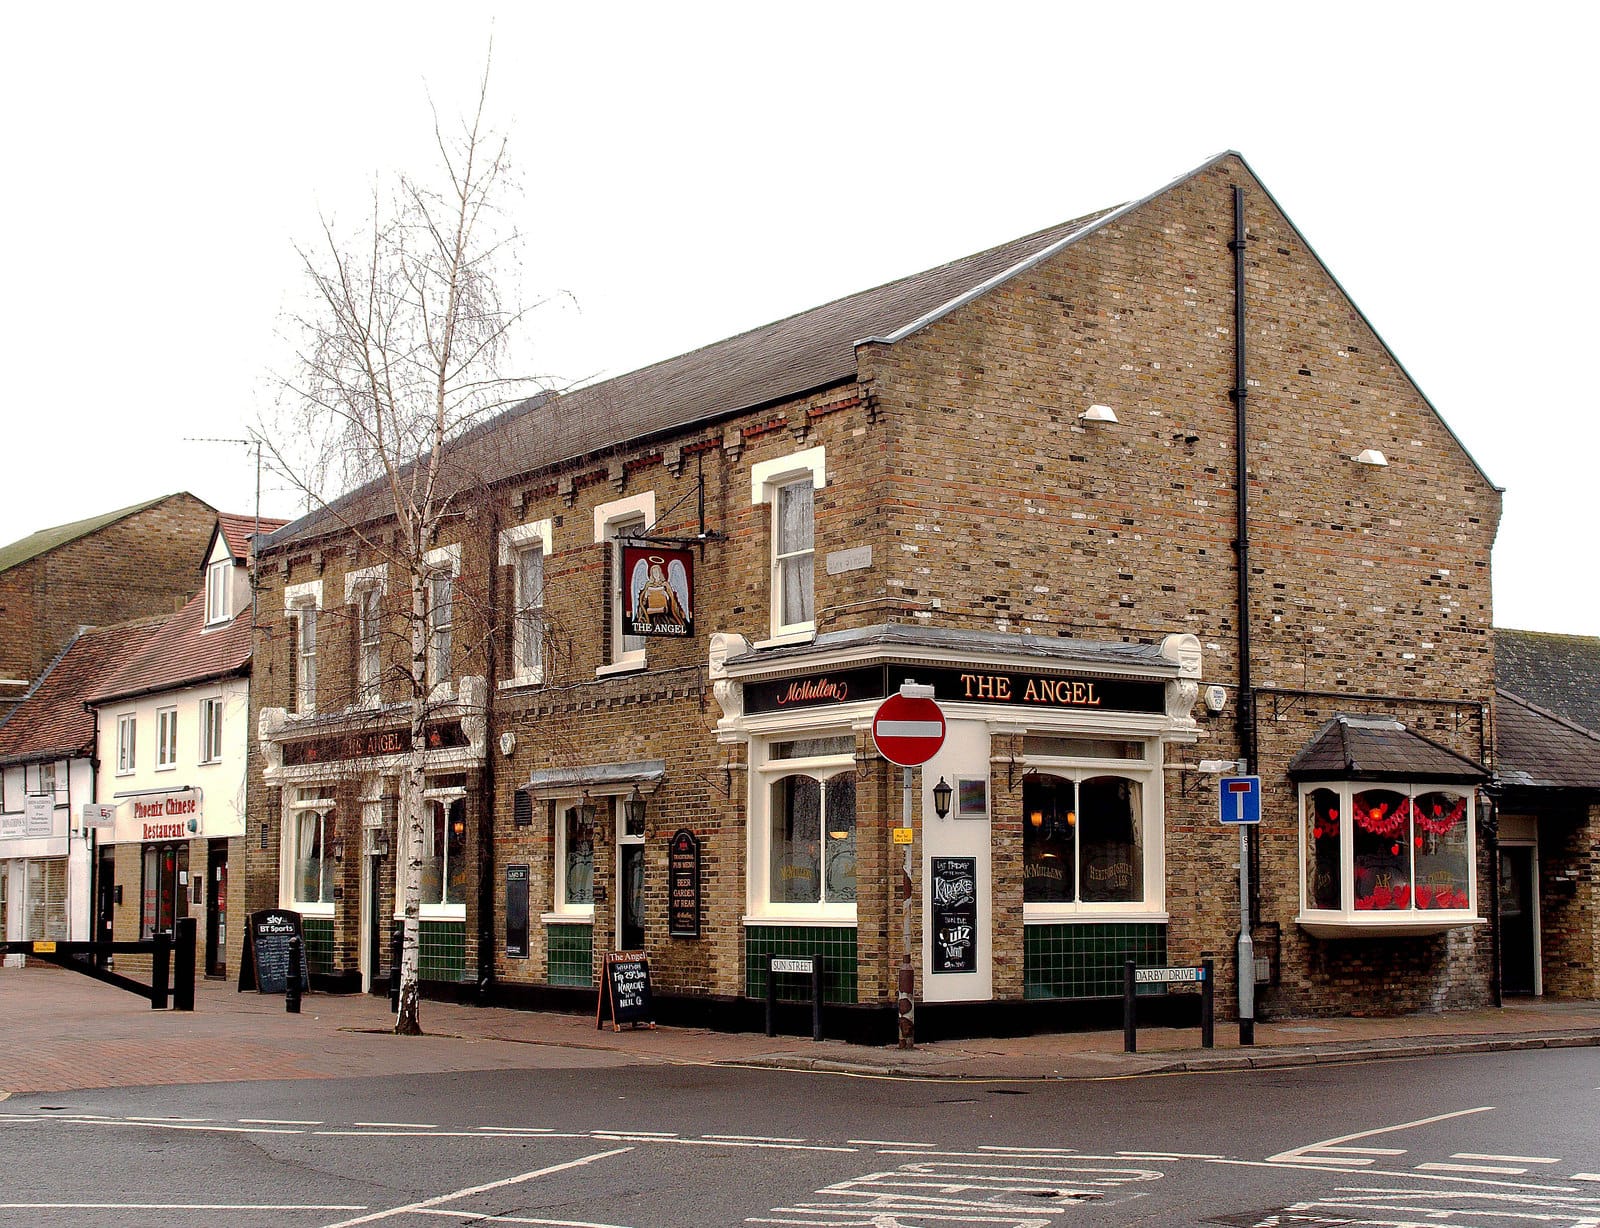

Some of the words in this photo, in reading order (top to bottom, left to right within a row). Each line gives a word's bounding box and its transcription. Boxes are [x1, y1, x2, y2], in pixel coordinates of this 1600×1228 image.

[632, 622, 652, 632] THE
[654, 624, 687, 634] ANGEL
[777, 678, 847, 704] McMullen
[960, 673, 1011, 700] THE
[1023, 679, 1101, 705] ANGEL
[367, 732, 403, 753] ANGEL
[134, 801, 163, 819] Phoenix
[165, 798, 196, 815] Chinese
[143, 822, 185, 839] Restaurant
[677, 879, 691, 887] BEER
[673, 889, 695, 897] GARDEN
[673, 900, 681, 908] AT
[681, 900, 695, 908] REAR
[267, 915, 282, 925] sky
[270, 925, 293, 933] Sports
[609, 953, 624, 961] The
[624, 951, 646, 962] Angel
[773, 961, 786, 971] SUN
[789, 961, 812, 972] STREET
[1135, 969, 1164, 982] DARBY
[1168, 968, 1194, 981] DRIVE
